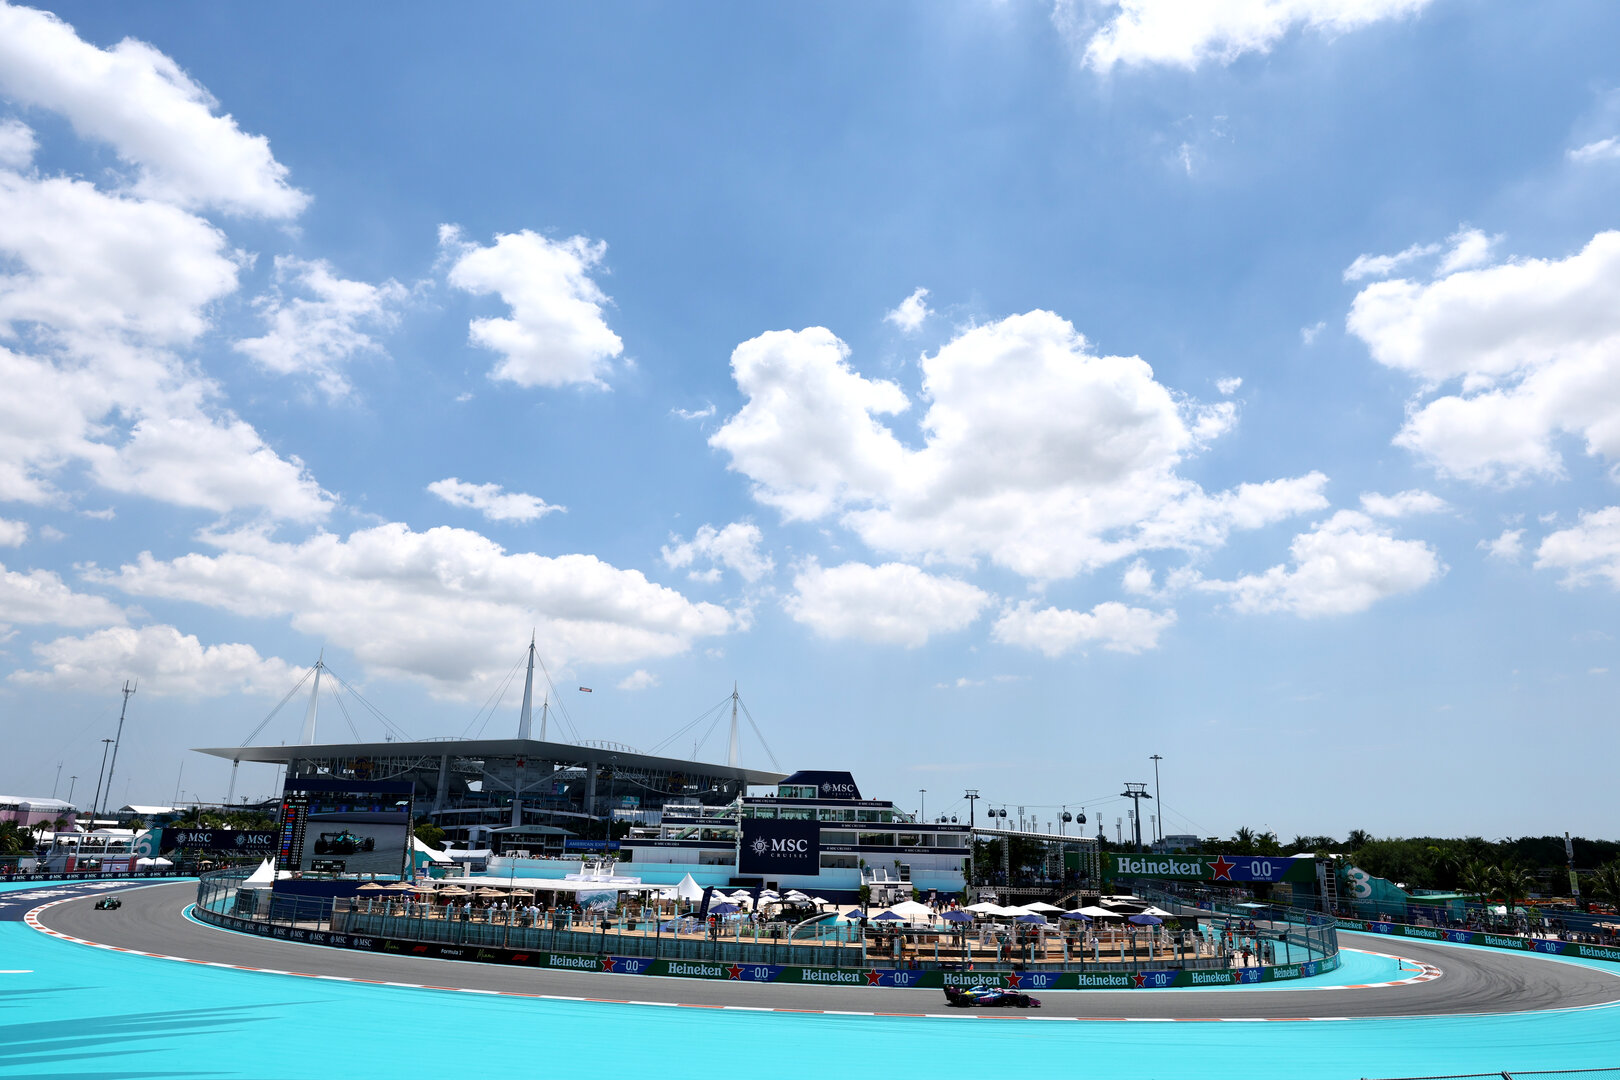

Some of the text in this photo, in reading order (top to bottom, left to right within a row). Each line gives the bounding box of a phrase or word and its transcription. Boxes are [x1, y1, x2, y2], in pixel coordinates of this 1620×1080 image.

[832, 783, 854, 792] MSC
[188, 832, 212, 842] MSC
[247, 834, 272, 844] MSC
[136, 834, 152, 858] 6
[770, 838, 808, 852] MSC
[1117, 858, 1272, 877] Heineken 0.0
[314, 932, 325, 941] MSC
[335, 935, 347, 944] MSC
[1404, 926, 1466, 941] Heineken 0.0
[359, 938, 372, 947] MSC
[1484, 935, 1556, 952] Heineken 0.0
[550, 954, 638, 971] Heineken 0.0
[668, 962, 768, 978] Heineken 0.0
[802, 969, 908, 983] Heineken 0.0
[1192, 970, 1258, 983] Heineken 0.0
[1273, 968, 1298, 978] Heineken
[943, 973, 1046, 986] Heineken 0.0
[1078, 974, 1167, 986] Heineken 0.0
